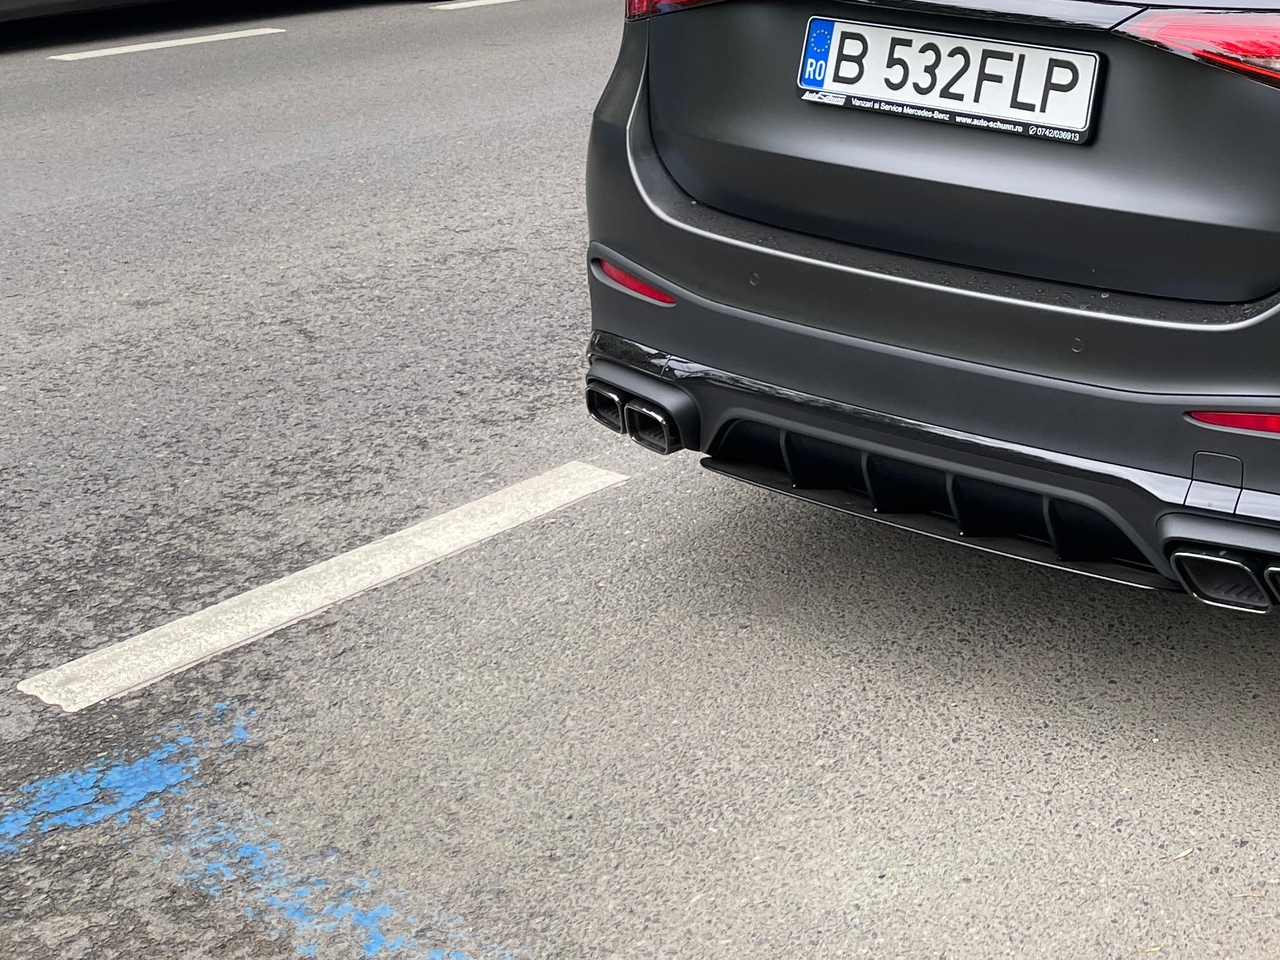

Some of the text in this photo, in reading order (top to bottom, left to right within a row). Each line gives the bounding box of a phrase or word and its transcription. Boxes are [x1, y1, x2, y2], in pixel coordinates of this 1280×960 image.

[804, 58, 825, 81] RO
[832, 30, 1080, 114] B 532FLP
[851, 97, 874, 108] Vanzari
[874, 101, 880, 109] si
[880, 102, 902, 113] Service
[902, 105, 950, 121] Mercedes-Benz
[955, 114, 1023, 133] www.auto-schunn.ro
